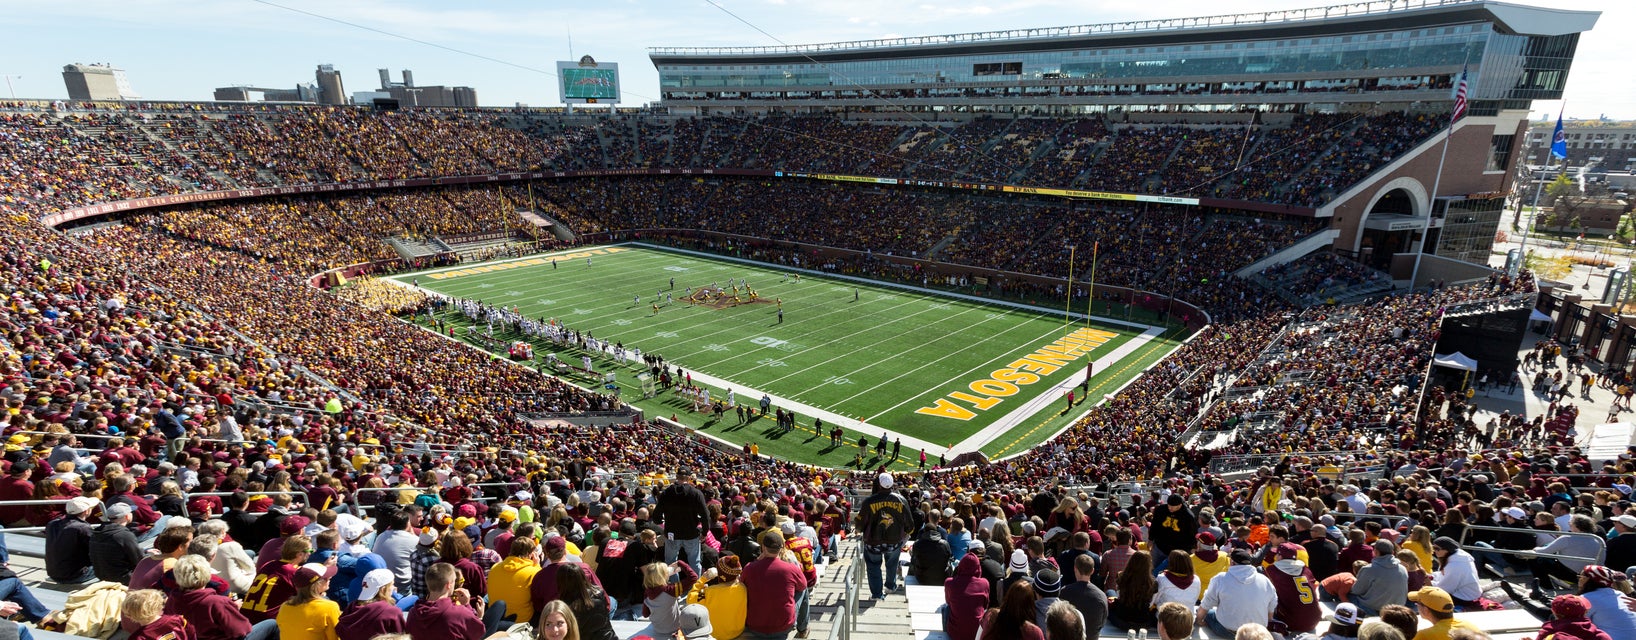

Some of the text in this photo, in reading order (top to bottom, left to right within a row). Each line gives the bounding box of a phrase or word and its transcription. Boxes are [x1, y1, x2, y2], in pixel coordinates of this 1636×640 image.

[170, 192, 230, 203] CHAMPIONSHIPS
[914, 327, 1120, 421] MINNESOTA
[870, 501, 903, 514] VIKINGS
[241, 573, 279, 613] 21
[1293, 575, 1314, 605] 5
[694, 616, 702, 627] V
